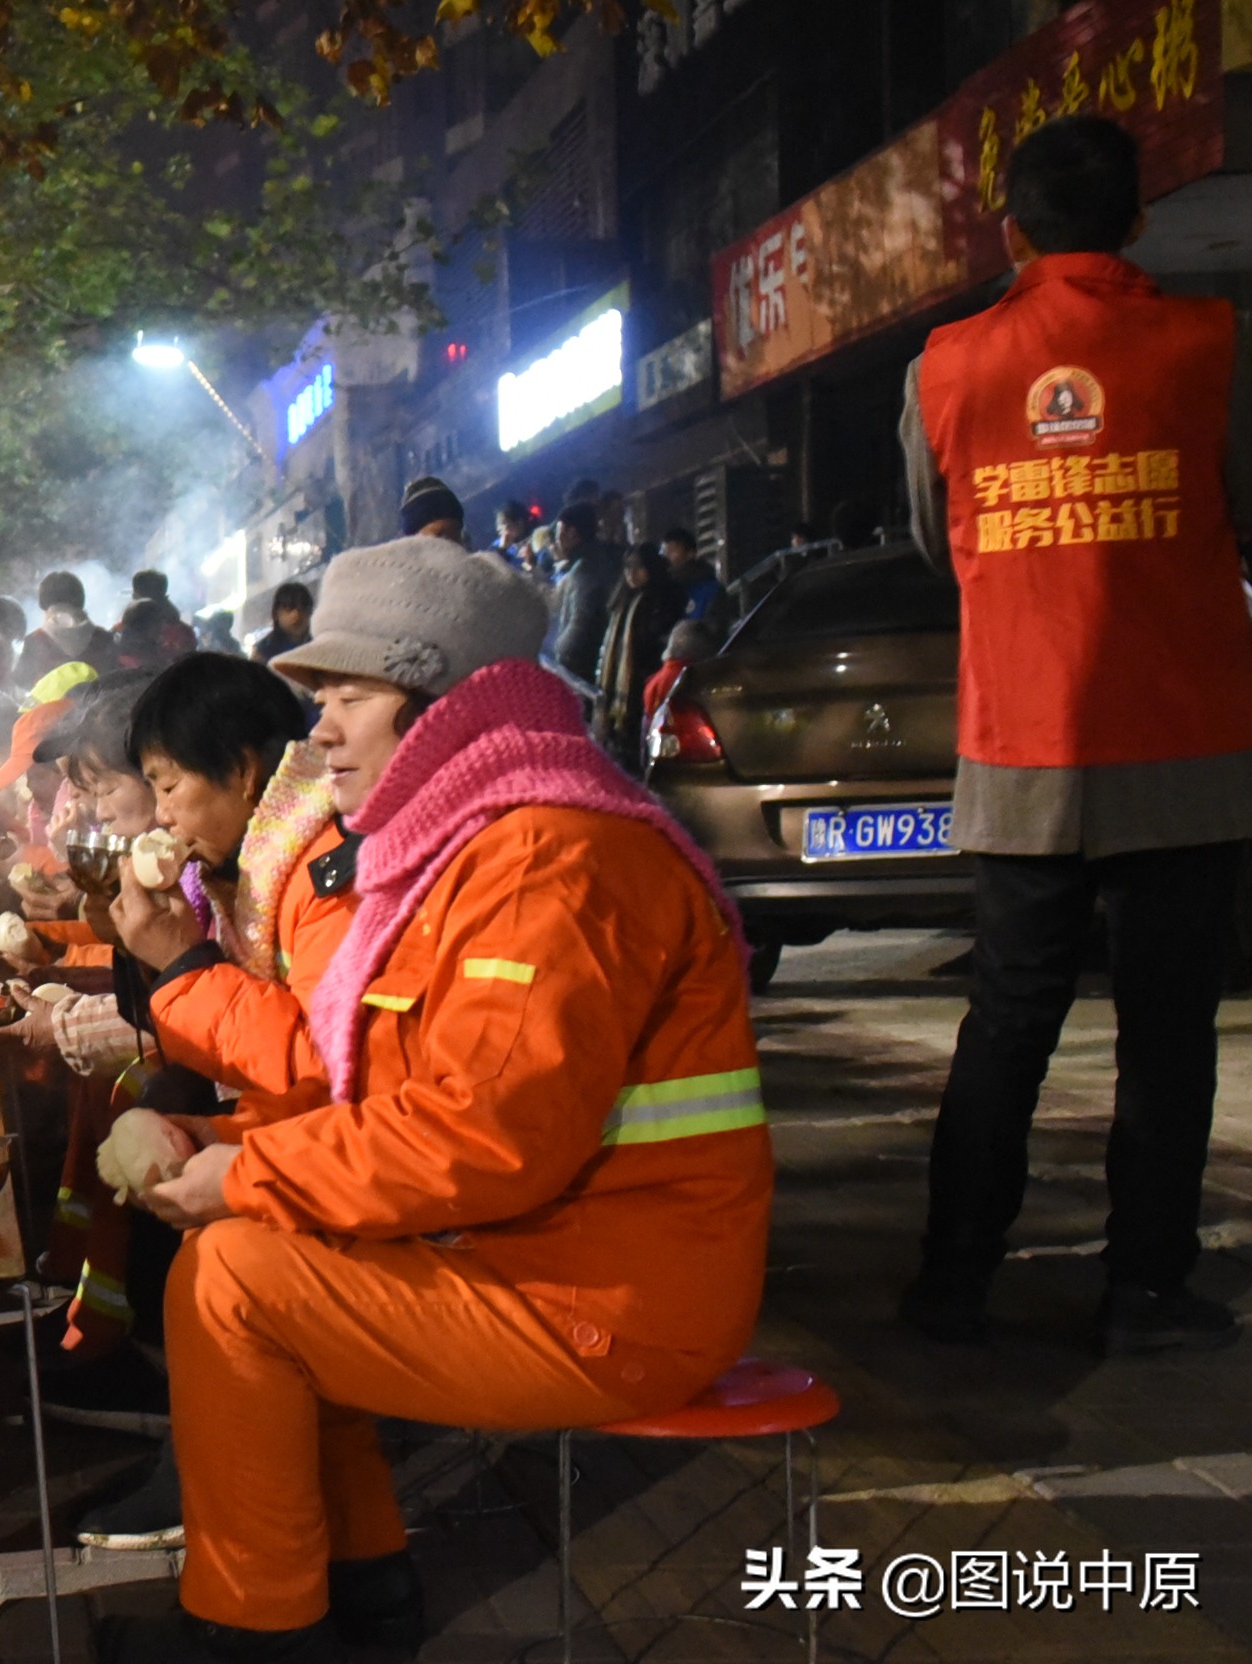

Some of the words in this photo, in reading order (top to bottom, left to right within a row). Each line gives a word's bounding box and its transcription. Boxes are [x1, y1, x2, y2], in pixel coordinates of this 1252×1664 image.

[973, 449, 1180, 507] 学雷锋志愿
[976, 496, 1181, 554] 服务公益行
